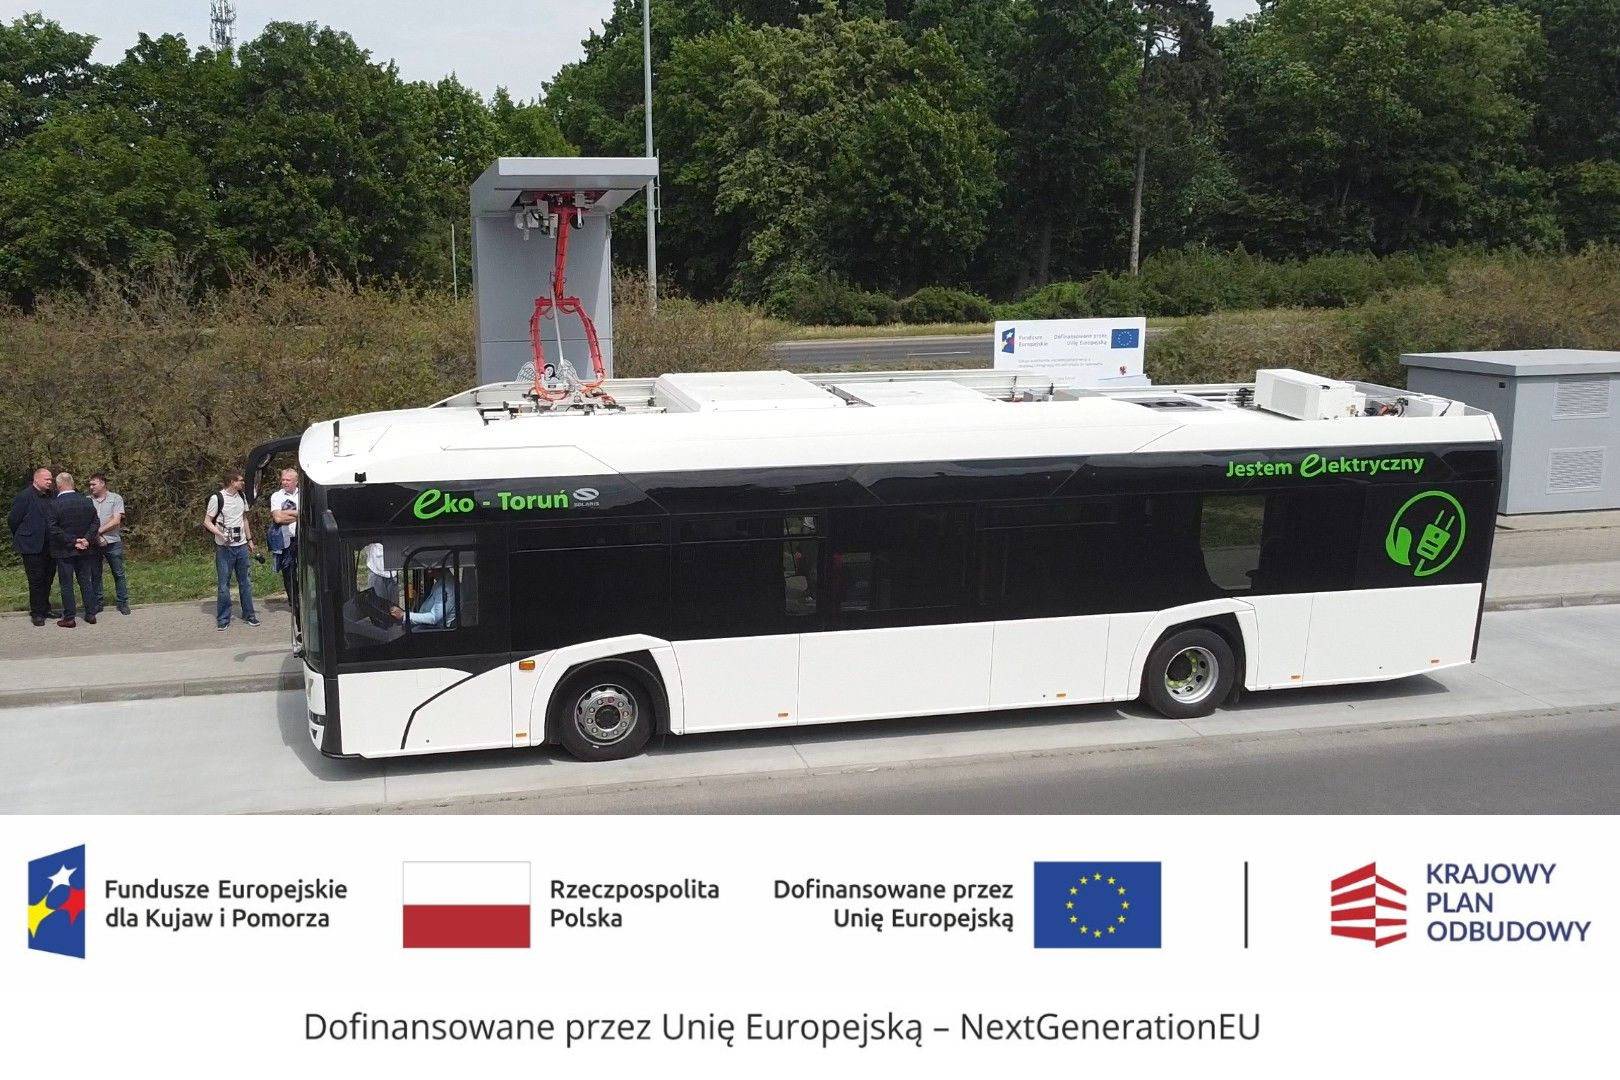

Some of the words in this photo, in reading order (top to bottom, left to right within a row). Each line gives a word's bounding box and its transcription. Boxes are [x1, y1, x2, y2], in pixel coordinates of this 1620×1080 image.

[1225, 460, 1294, 478] Jestem
[1299, 453, 1425, 478] elektryczny
[413, 489, 475, 520] eko
[497, 489, 569, 511] Toruń
